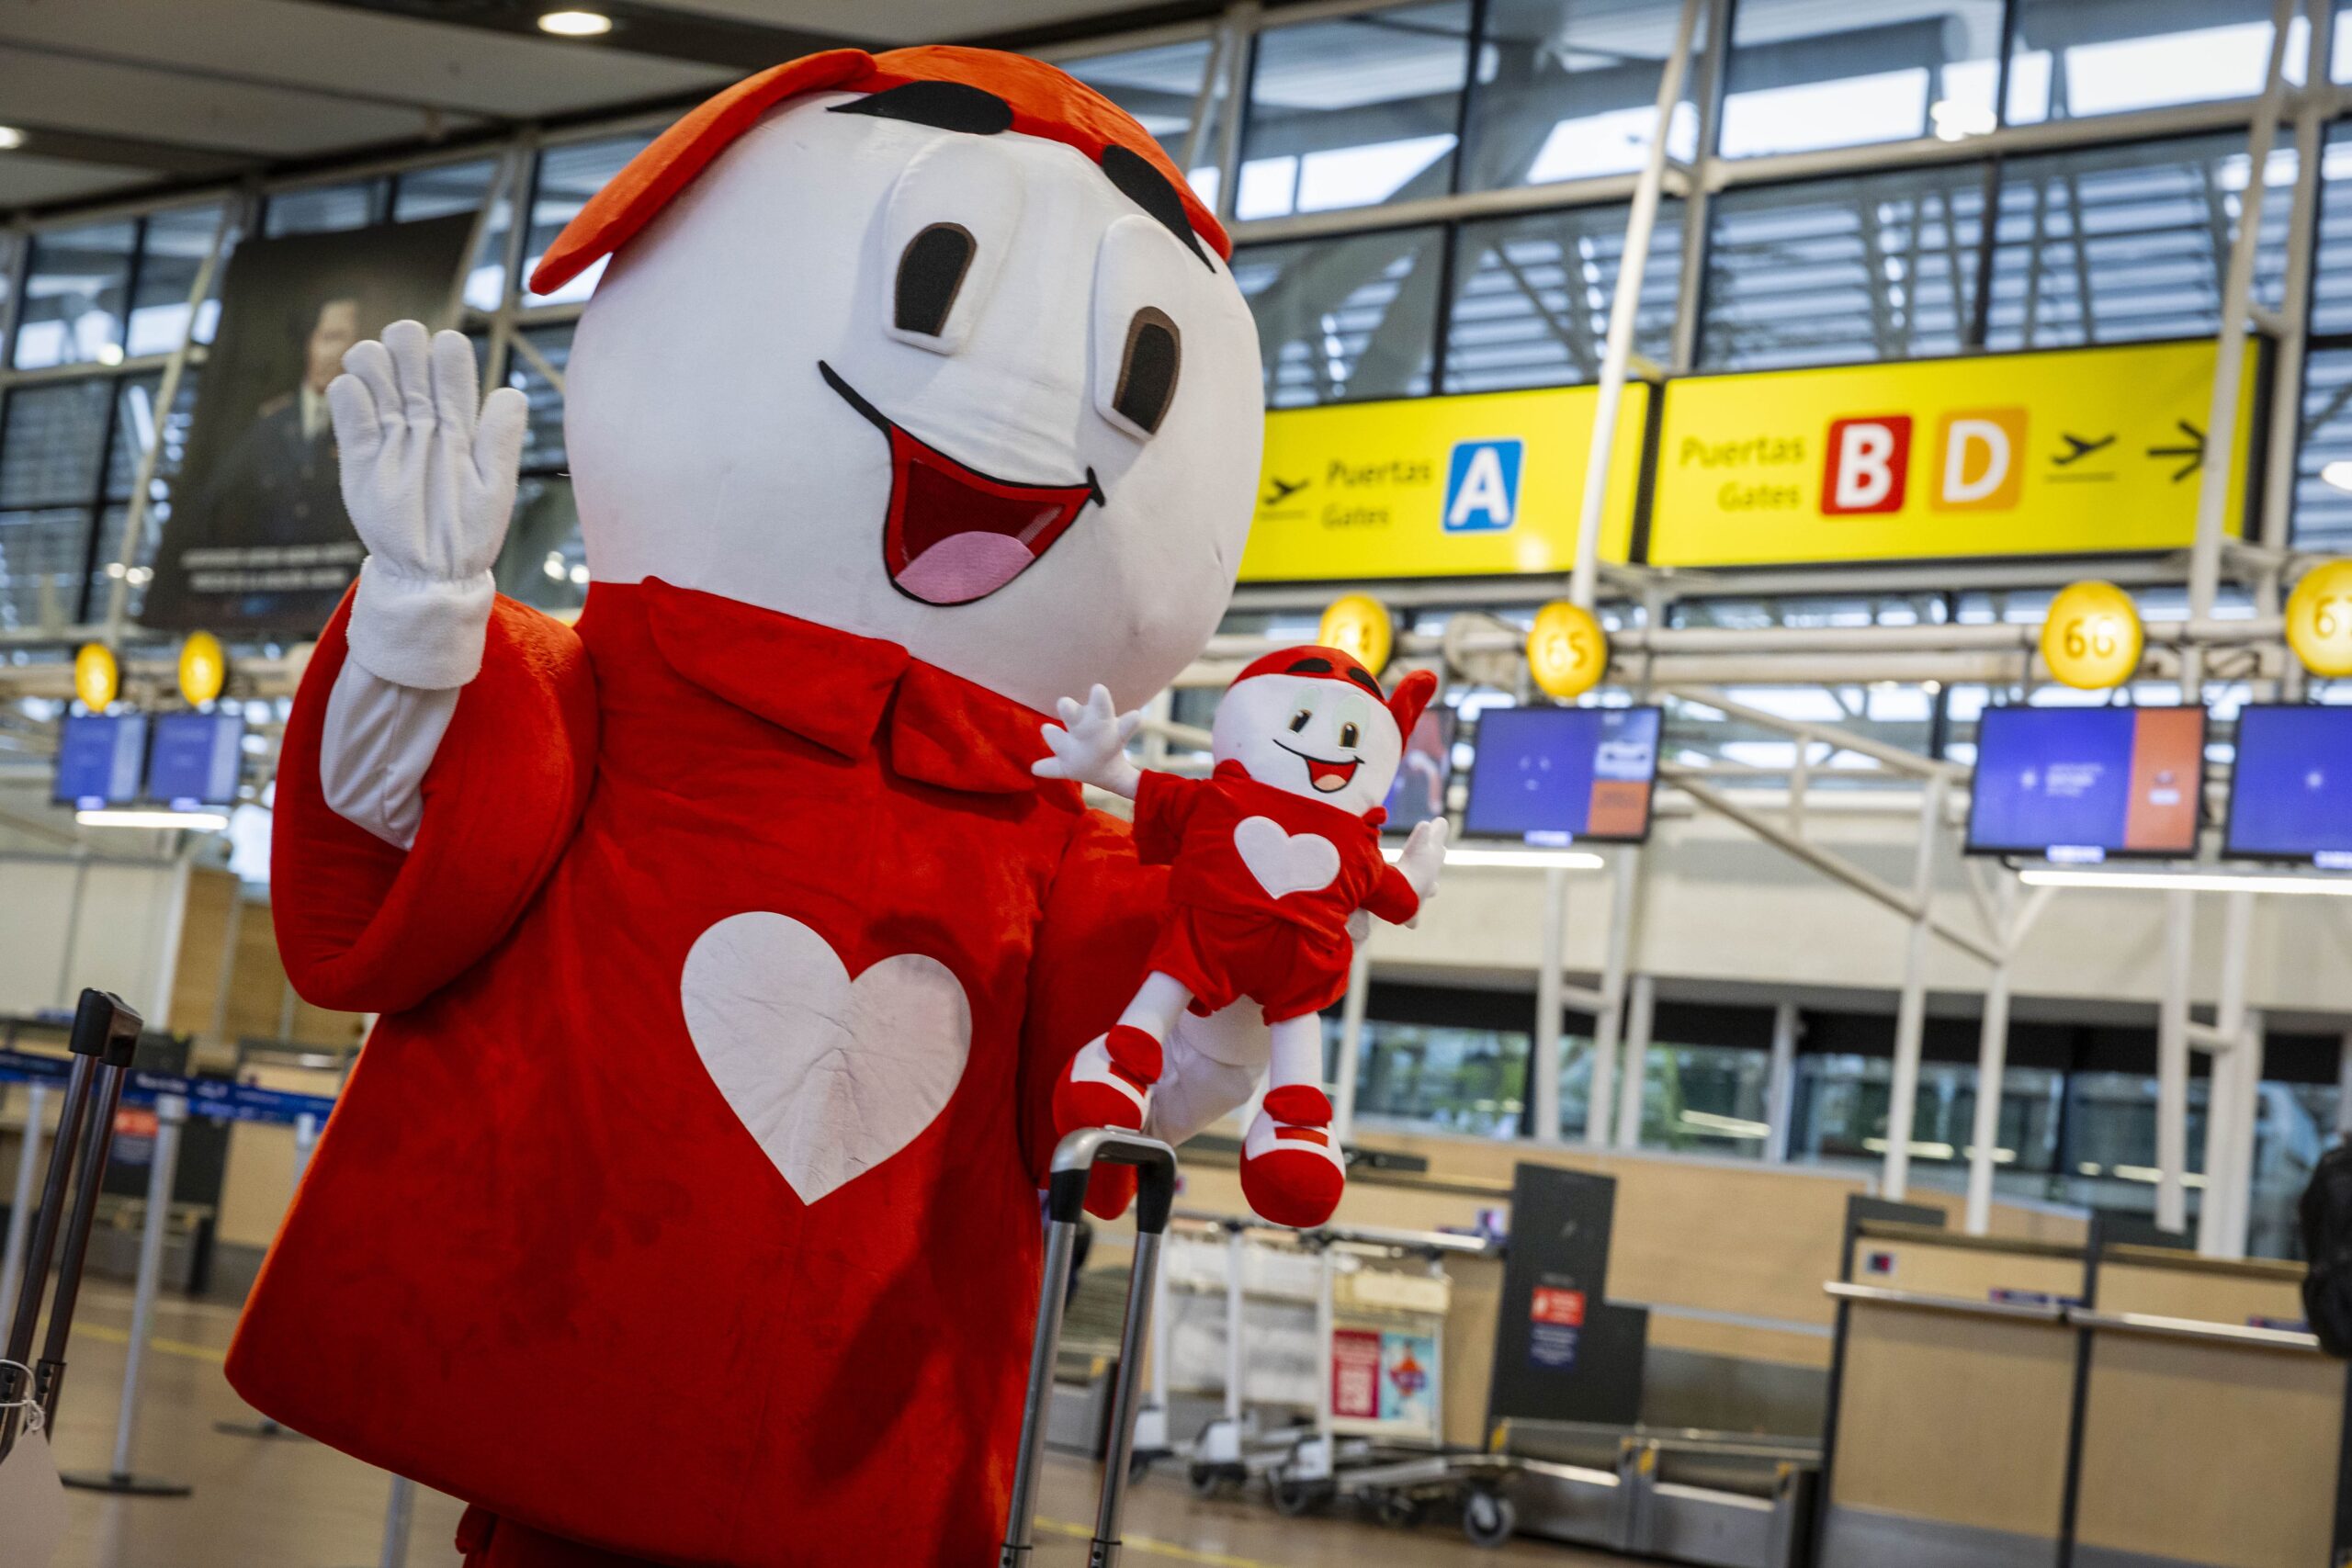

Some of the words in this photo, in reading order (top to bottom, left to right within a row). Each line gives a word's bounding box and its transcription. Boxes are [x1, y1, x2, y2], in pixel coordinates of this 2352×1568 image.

[1680, 435, 1806, 468] Puertas
[1835, 423, 1895, 509] B
[1941, 419, 2010, 504] D
[1326, 457, 1431, 488] Puertas
[1446, 446, 1511, 527] A
[1717, 480, 1800, 513] Gates
[1545, 630, 1589, 672] 65
